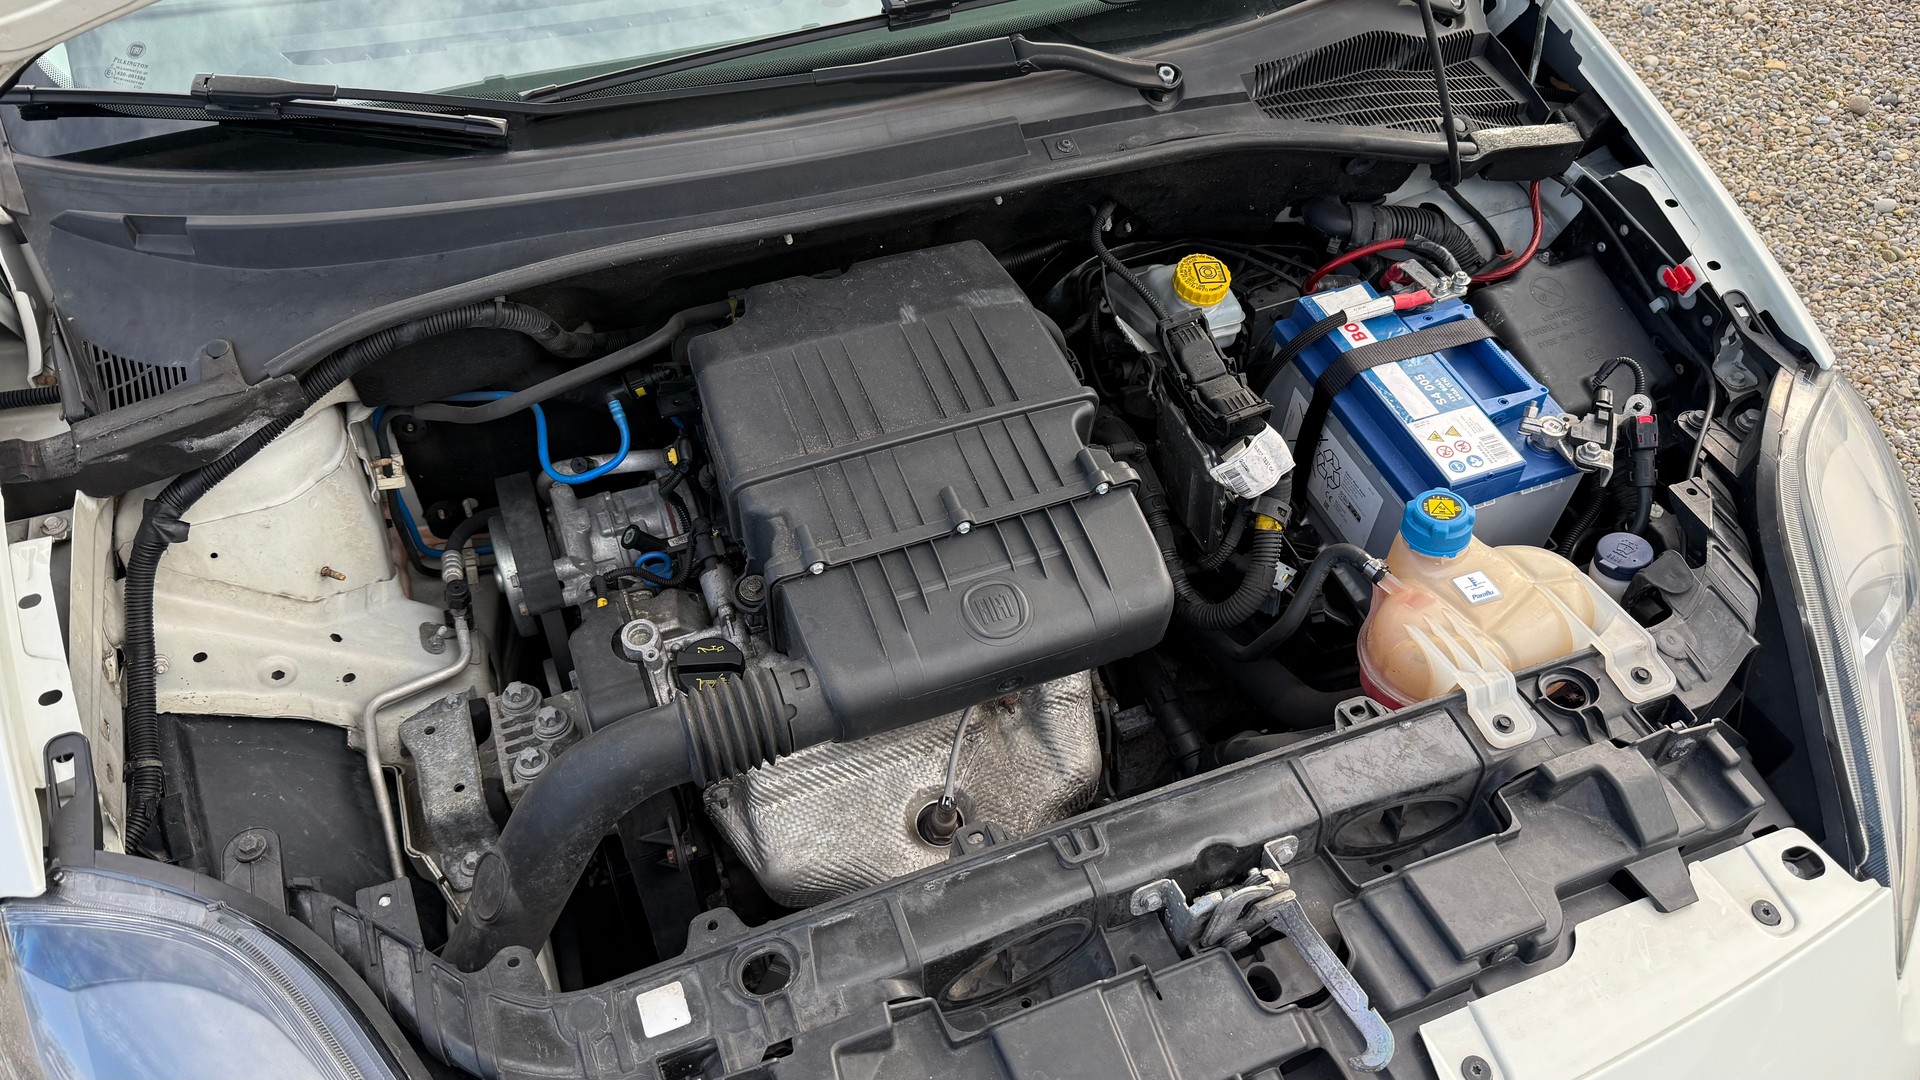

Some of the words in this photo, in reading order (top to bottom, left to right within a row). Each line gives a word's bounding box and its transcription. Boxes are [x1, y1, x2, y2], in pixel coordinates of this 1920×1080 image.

[113, 57, 149, 69] PILKINGTON
[1344, 323, 1368, 342] BO
[1415, 374, 1435, 391] 005
[1430, 392, 1447, 405] S4
[1471, 590, 1495, 600] Paraflu
[973, 591, 1017, 626] FIAT
